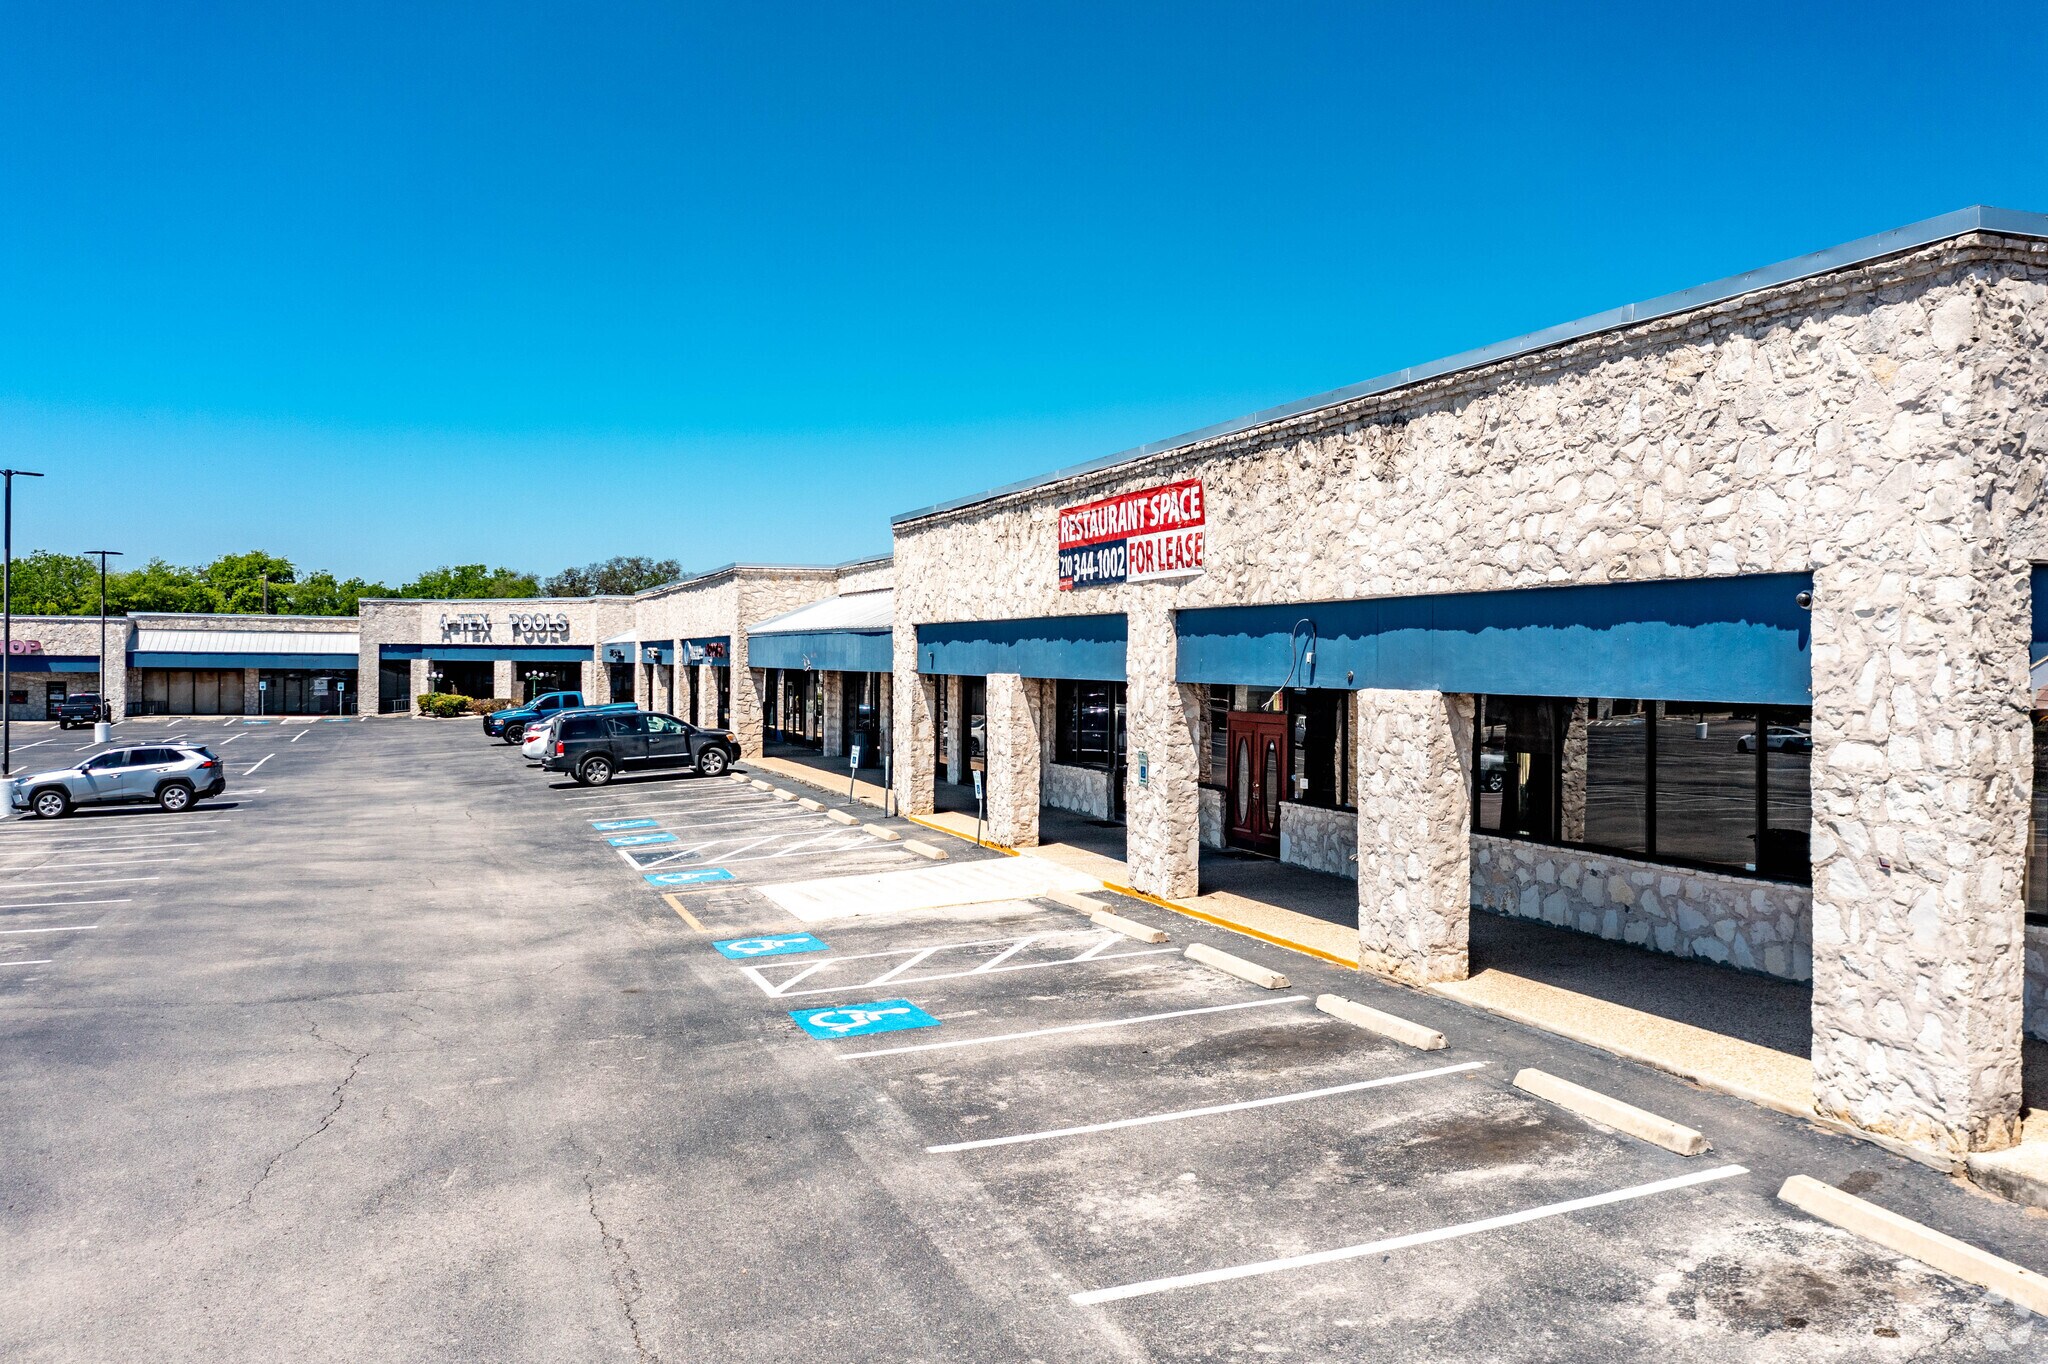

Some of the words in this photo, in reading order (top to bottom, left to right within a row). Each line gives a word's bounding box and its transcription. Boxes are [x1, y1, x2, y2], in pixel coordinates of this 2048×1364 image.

[1061, 498, 1149, 543] RESTAURANT
[1149, 486, 1201, 526] SPACE
[1060, 555, 1073, 577] 210
[1073, 546, 1126, 582] 344-1002
[1129, 541, 1155, 575] FOR
[1158, 531, 1203, 571] LEASE
[439, 613, 490, 631] A-TEX
[509, 612, 568, 632] POOLS
